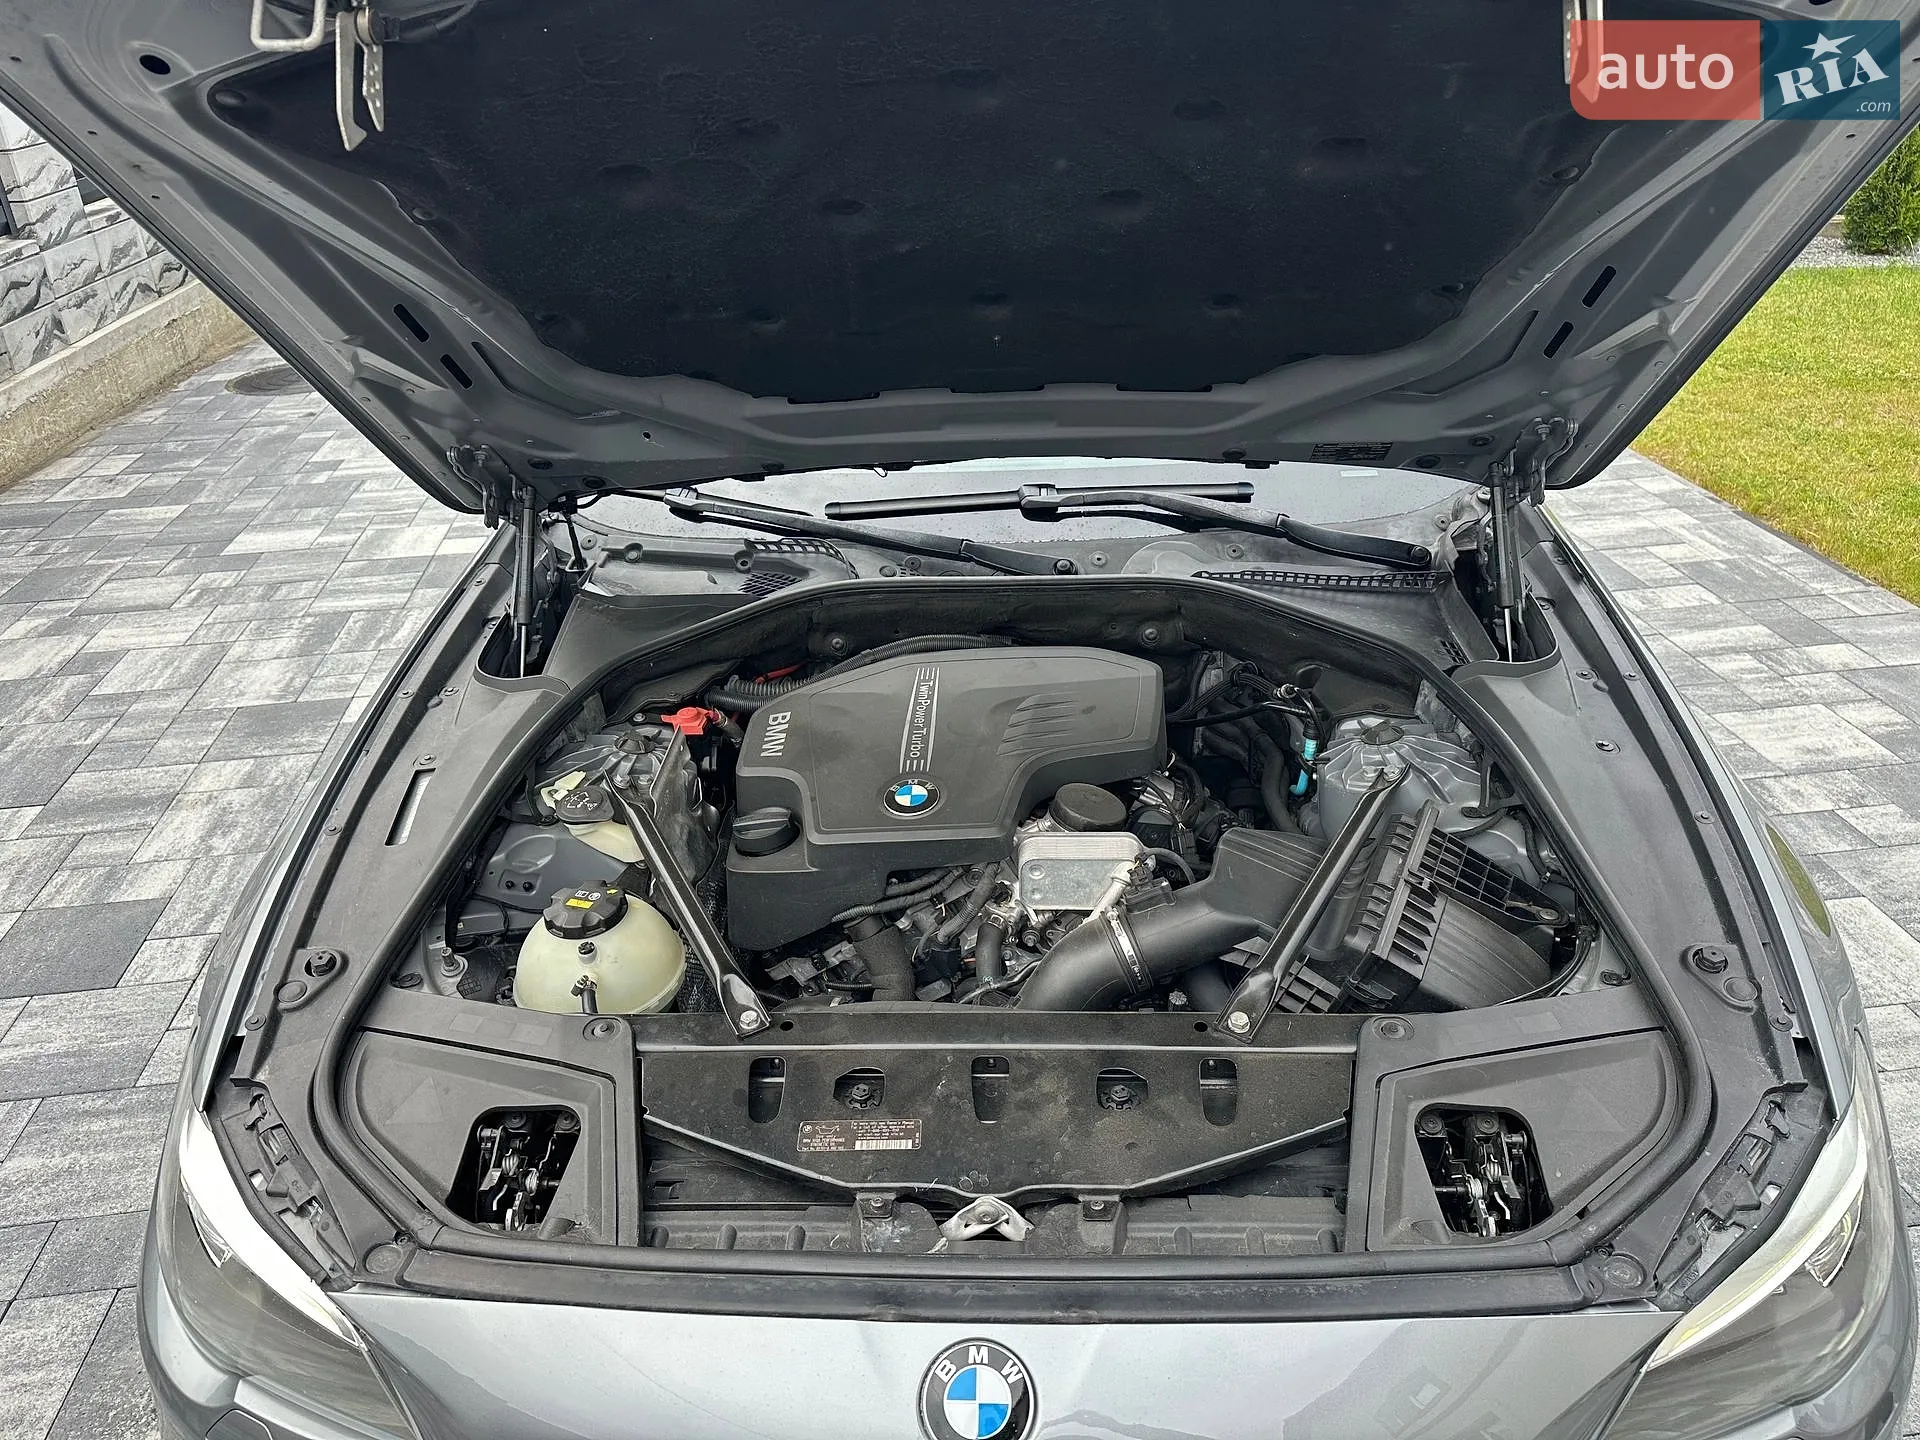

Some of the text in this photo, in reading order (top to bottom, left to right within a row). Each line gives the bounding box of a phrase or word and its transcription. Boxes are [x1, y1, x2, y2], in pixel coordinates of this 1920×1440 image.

[760, 711, 792, 757] BMW
[910, 728, 927, 758] Turbo
[934, 1345, 1024, 1384] BMW
